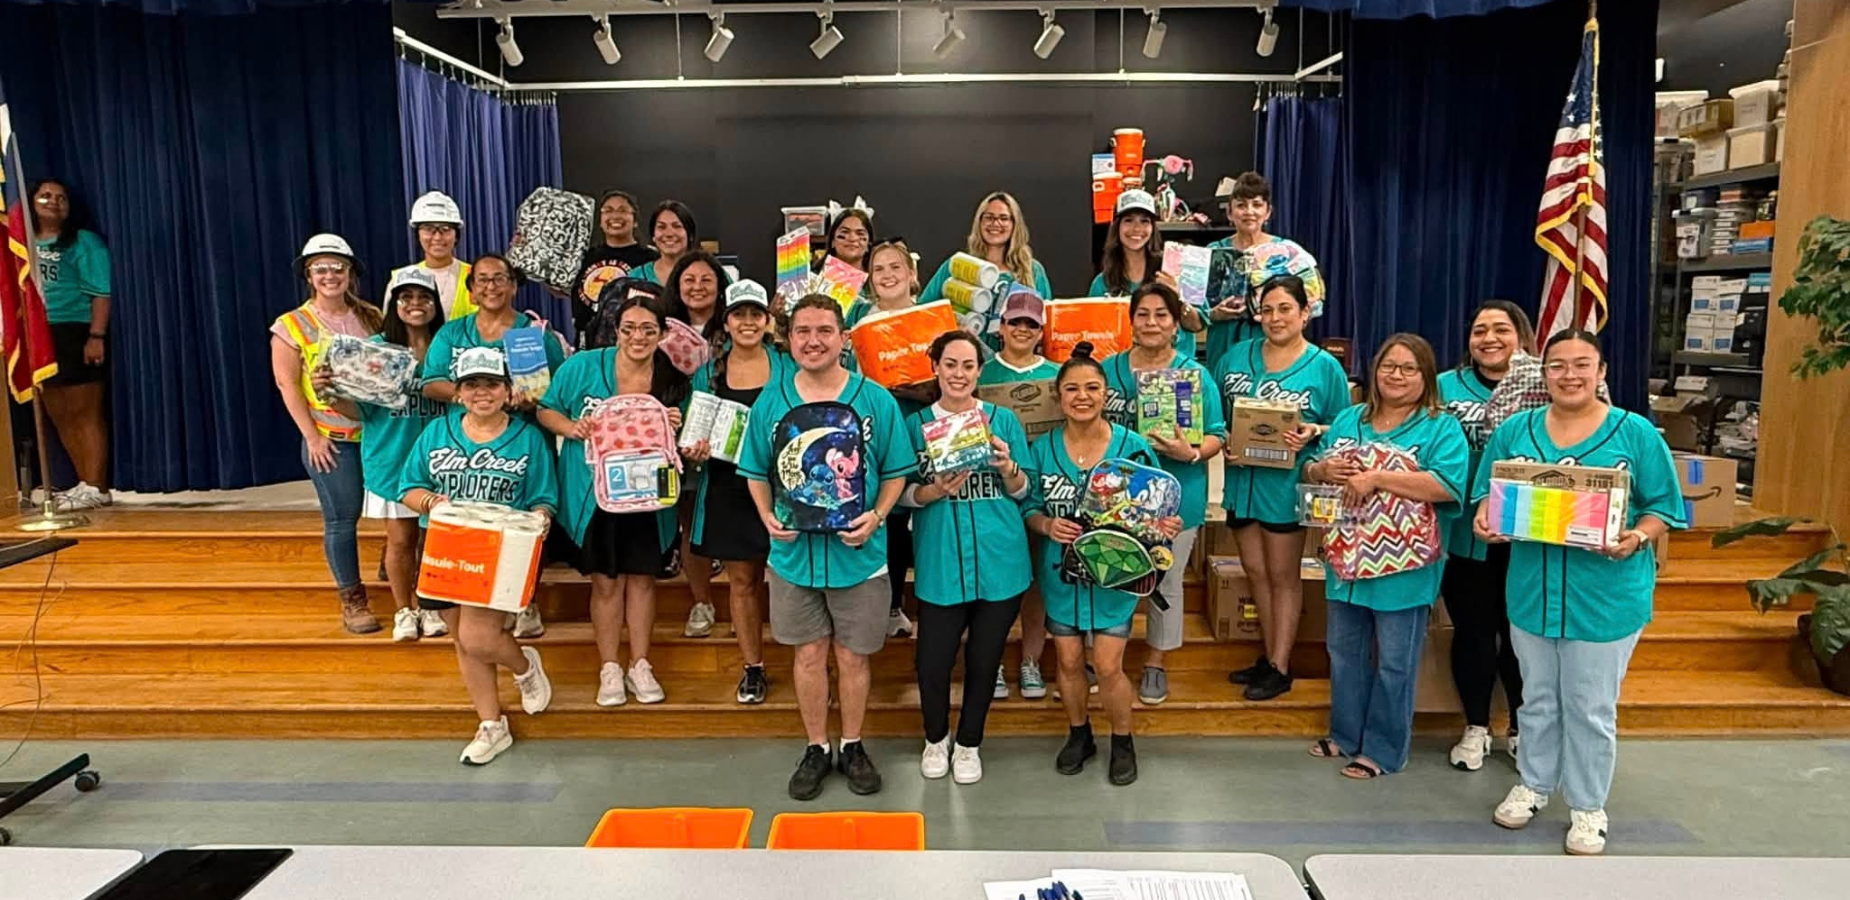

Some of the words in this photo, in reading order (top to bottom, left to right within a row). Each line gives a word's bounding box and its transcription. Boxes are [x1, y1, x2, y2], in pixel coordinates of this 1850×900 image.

[1051, 332, 1079, 342] Paper
[1080, 331, 1114, 341] Towels
[878, 348, 908, 362] Paper
[1224, 373, 1253, 396] Elm
[1255, 380, 1311, 410] Creek
[429, 446, 467, 475] Elm
[469, 448, 529, 477] Creek
[611, 468, 623, 482] 2
[1040, 474, 1075, 502] Elm
